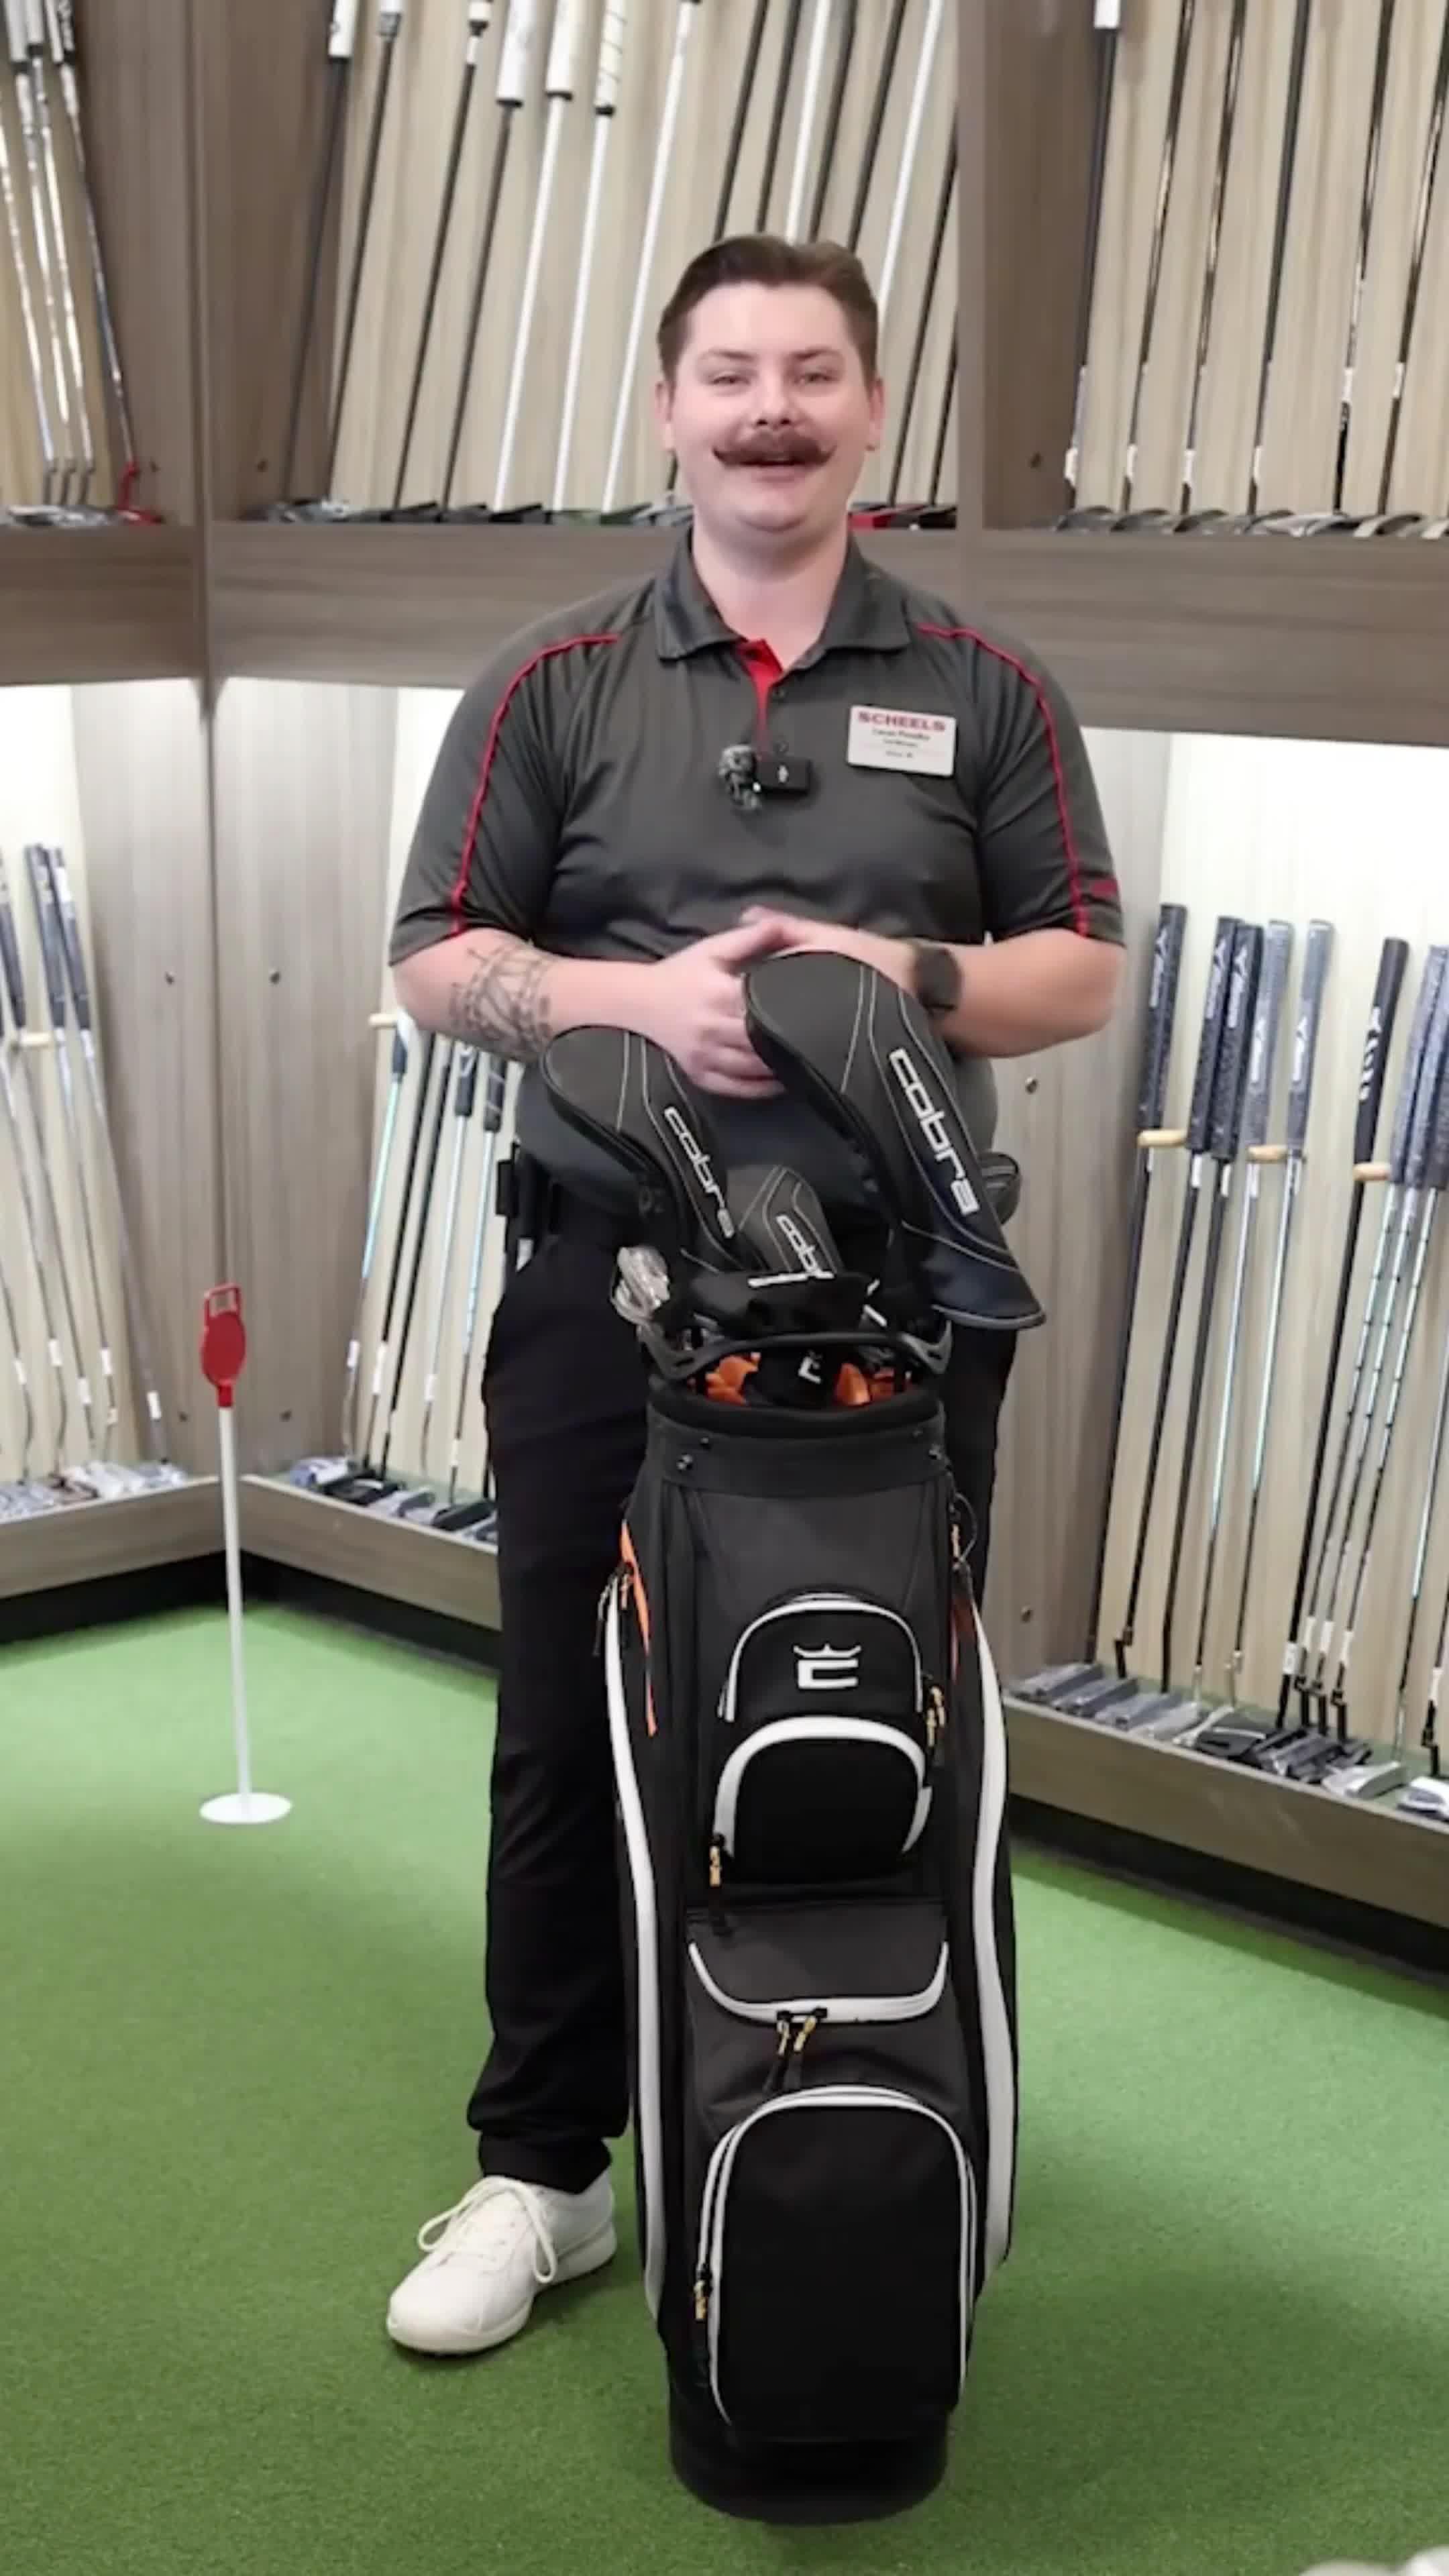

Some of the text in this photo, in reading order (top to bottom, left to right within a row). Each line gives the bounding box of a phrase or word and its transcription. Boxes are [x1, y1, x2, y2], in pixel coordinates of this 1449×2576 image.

[858, 712, 945, 732] SCHEELS
[664, 1107, 735, 1238] cobra
[889, 1047, 980, 1216] cobra
